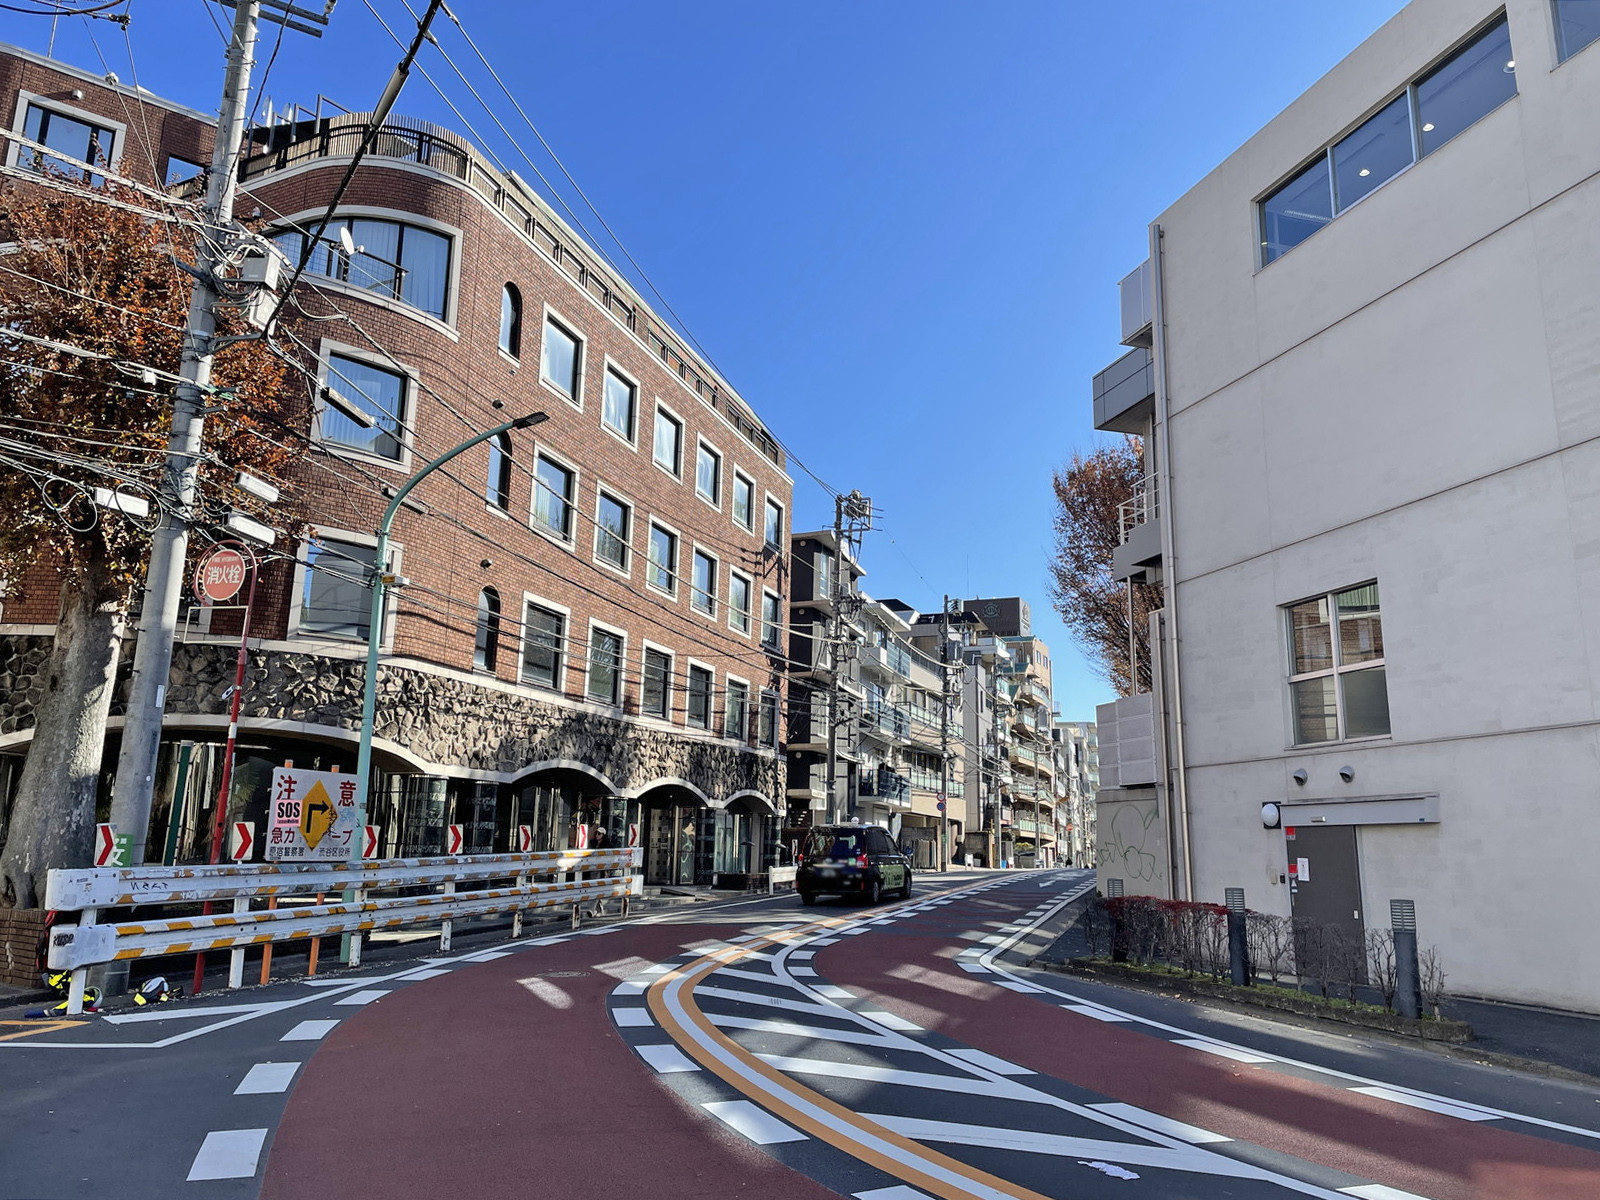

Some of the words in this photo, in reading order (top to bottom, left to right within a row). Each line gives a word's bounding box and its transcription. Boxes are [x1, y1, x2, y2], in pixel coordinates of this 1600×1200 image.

[207, 565, 241, 584] 消火栓
[277, 802, 300, 818] SOS
